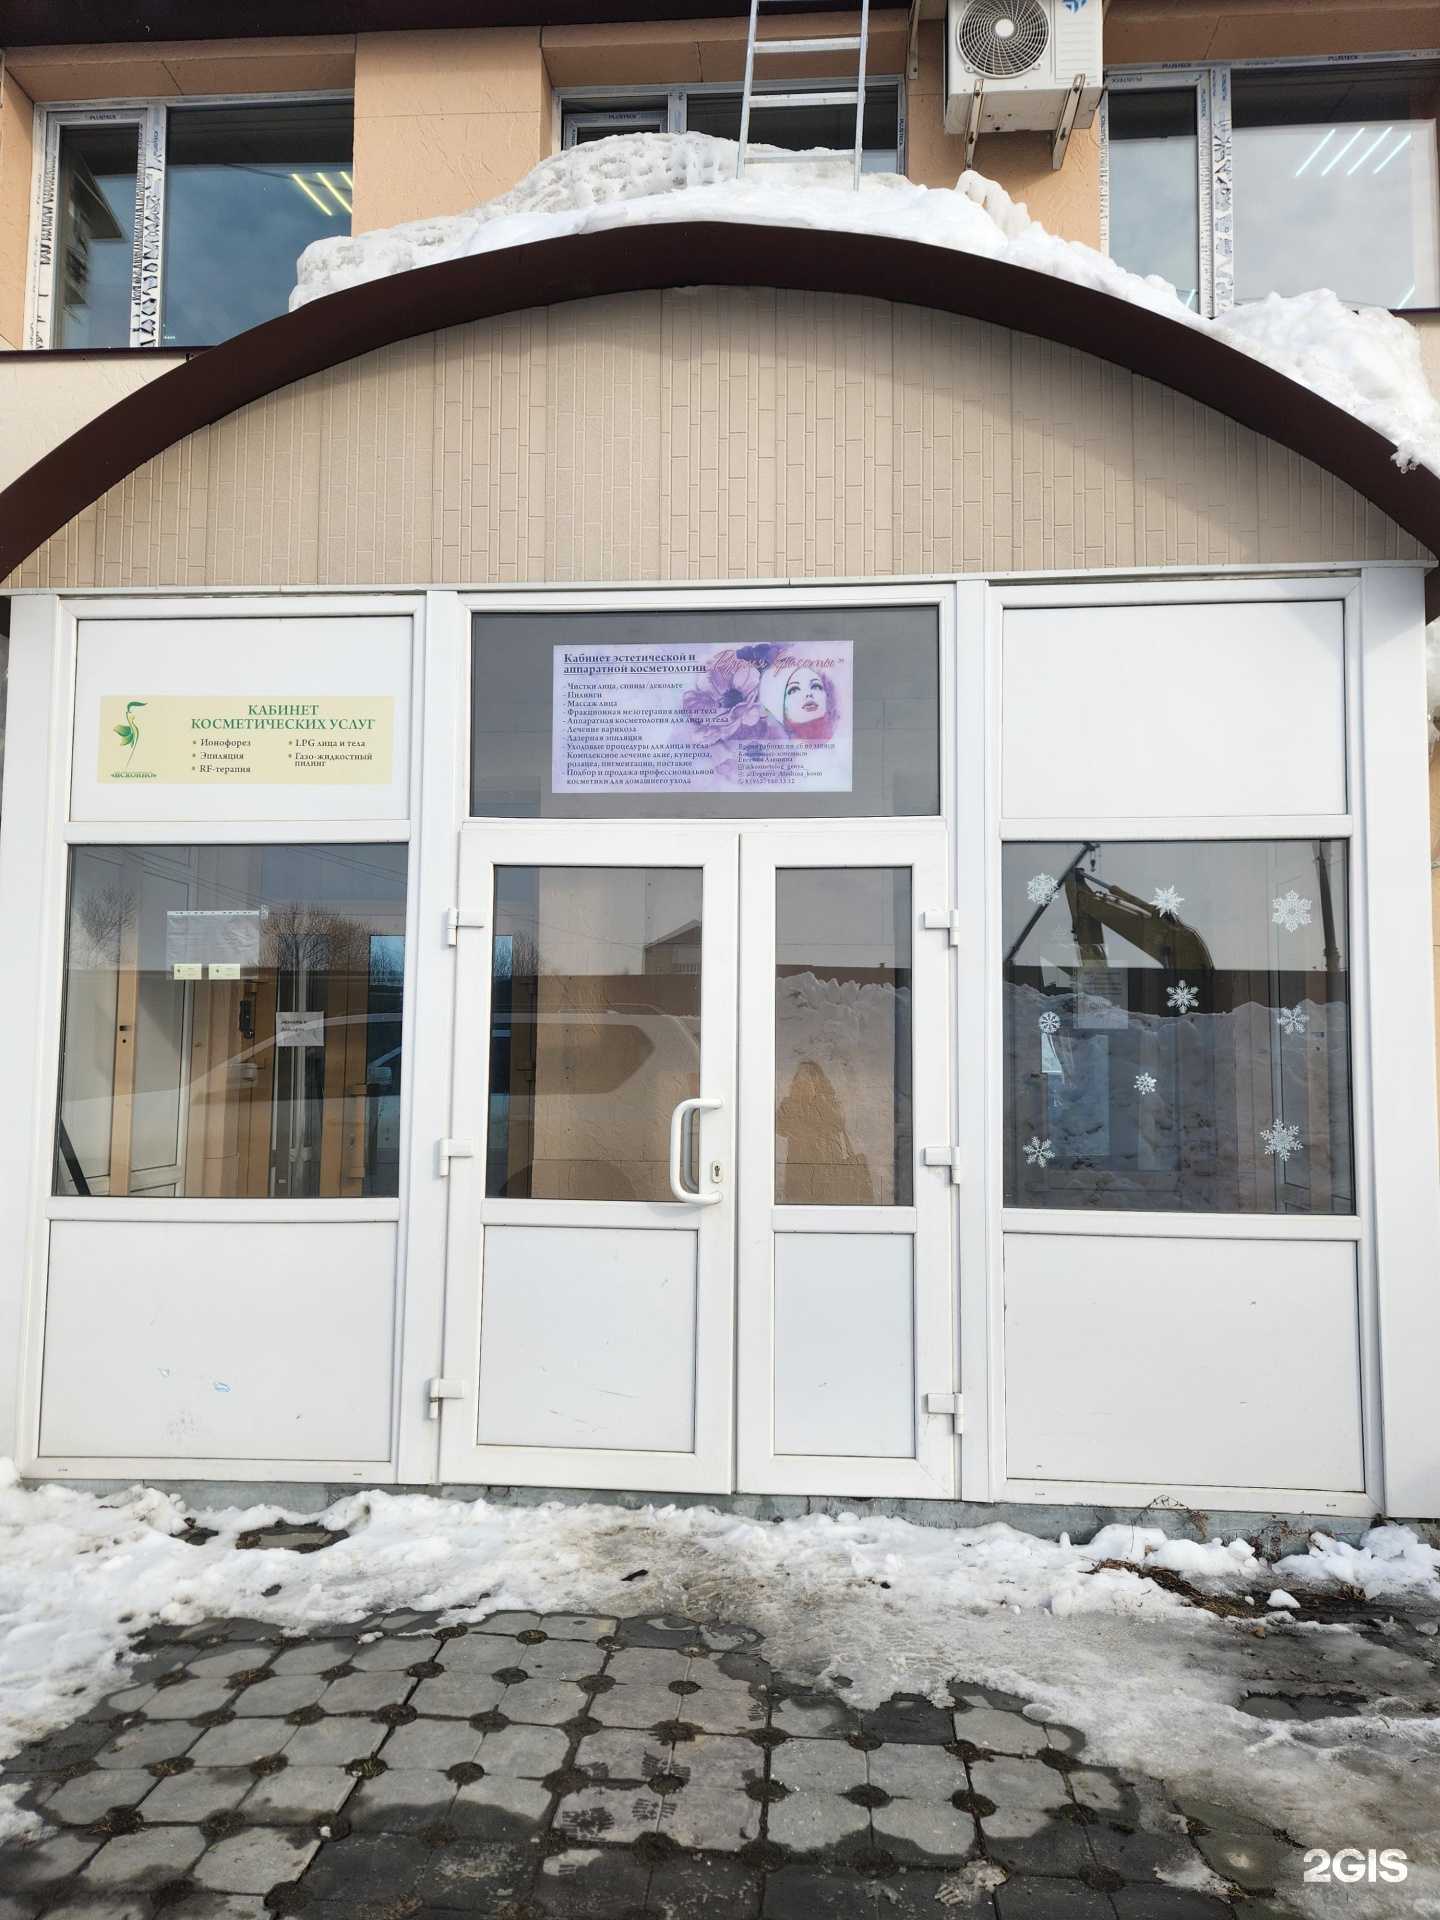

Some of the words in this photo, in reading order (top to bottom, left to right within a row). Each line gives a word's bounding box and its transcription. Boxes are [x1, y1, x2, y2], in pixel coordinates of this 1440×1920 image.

[564, 653, 610, 663] Кабинет
[613, 652, 686, 662] эстетической
[688, 654, 696, 662] и
[563, 664, 628, 675] аппаратной
[630, 664, 706, 673] косметологии
[567, 682, 598, 690] Чистки
[567, 691, 603, 699] Пилинги
[567, 700, 598, 708] Массаж
[248, 704, 320, 716] КАБИНЕТ
[567, 708, 621, 717] Фракционная
[622, 709, 672, 717] мезотерапия
[673, 708, 693, 716] лица
[191, 718, 327, 730] КОСМЕТИЧЕСКИХ
[329, 718, 376, 730] УСЛУГ
[567, 717, 614, 725] Аппаратная
[615, 717, 669, 725] косметология
[601, 726, 637, 734] варикоза
[200, 738, 251, 749] Ионофорез
[295, 738, 316, 747] LPG
[317, 740, 338, 748] лица
[567, 735, 604, 743] Лазерная
[605, 735, 642, 743] эпиляция
[567, 743, 605, 751] Уходовые
[606, 743, 649, 752] процедуры
[200, 751, 244, 761] Эпиляция
[295, 751, 373, 761] Газо-жидкостный
[567, 752, 619, 761] Комплексное
[652, 752, 673, 760] акне,
[674, 752, 713, 760] купероза,
[199, 763, 251, 775] RF-терапия
[567, 769, 597, 777] Подбор
[604, 769, 638, 777] продажа
[639, 767, 714, 777] профессиональной
[625, 777, 669, 785] домашнего
[670, 777, 691, 786] ухода
